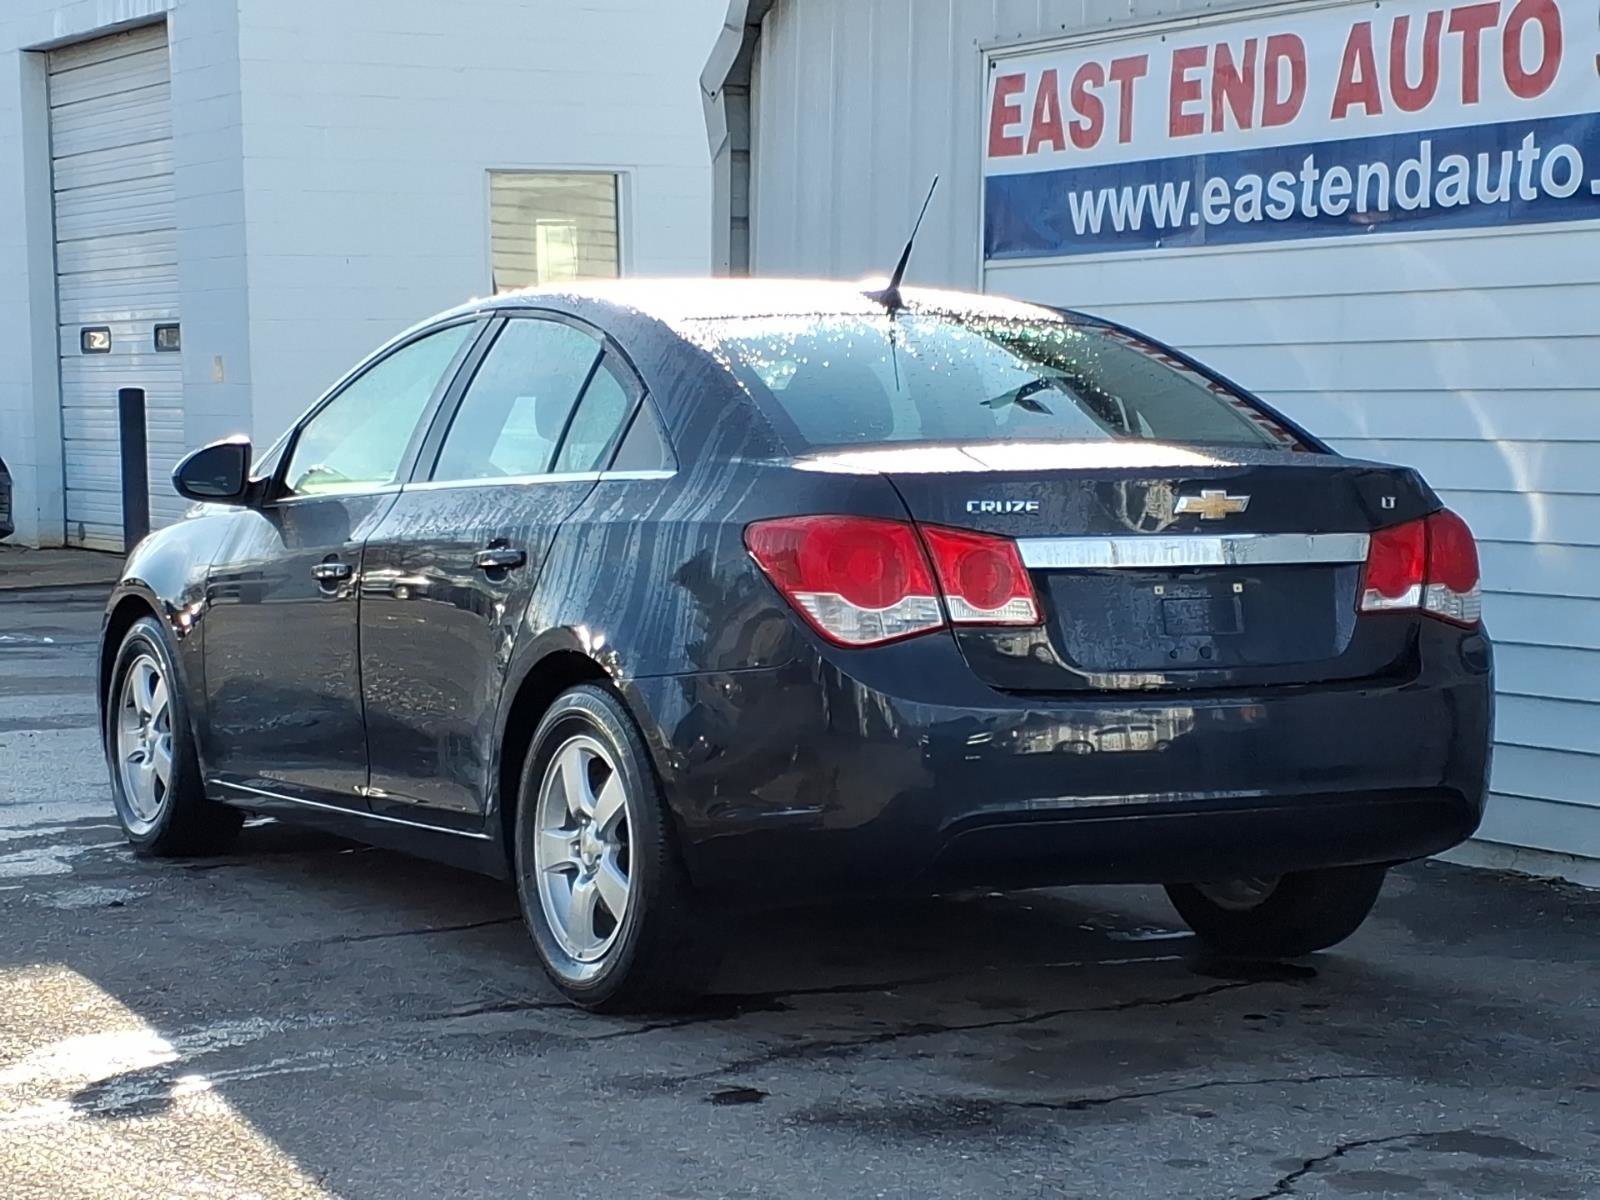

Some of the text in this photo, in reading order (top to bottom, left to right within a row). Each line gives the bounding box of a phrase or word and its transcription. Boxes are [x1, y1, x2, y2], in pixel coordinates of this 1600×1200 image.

[987, 54, 1149, 158] EAST
[1168, 33, 1307, 138] END
[1330, 0, 1563, 120] AUTO
[966, 500, 1040, 514] CRUZE
[1381, 496, 1396, 509] LT
